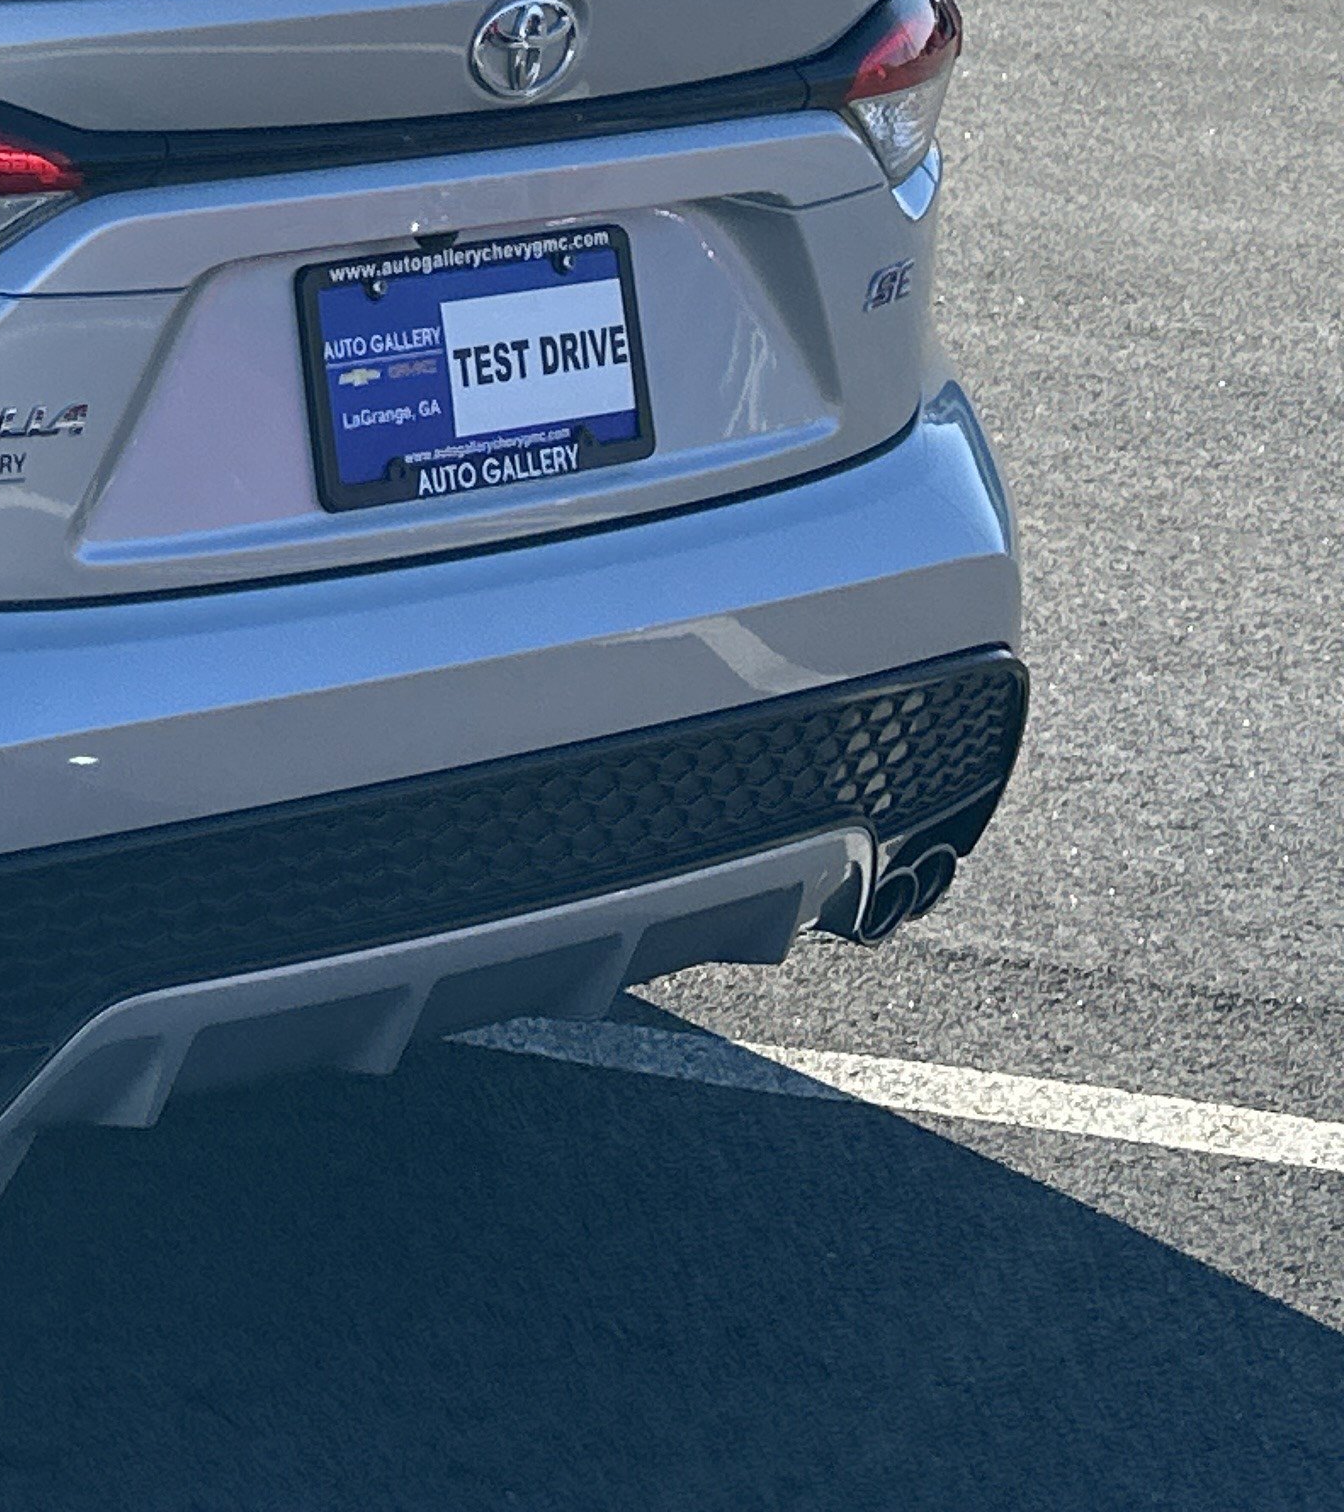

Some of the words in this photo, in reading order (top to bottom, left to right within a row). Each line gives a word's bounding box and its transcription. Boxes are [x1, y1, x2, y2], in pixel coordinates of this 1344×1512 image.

[328, 230, 610, 283] www.autogallerychevygmc.com
[863, 258, 915, 313] SE
[324, 336, 367, 361] AUTO
[370, 326, 441, 354] GALLERY
[453, 338, 530, 388] TEST
[540, 325, 628, 376] DRIVE
[342, 406, 417, 430] LaGrange,
[418, 399, 442, 417] GA
[418, 461, 476, 496] AUTO
[481, 443, 579, 483] GALLERY
